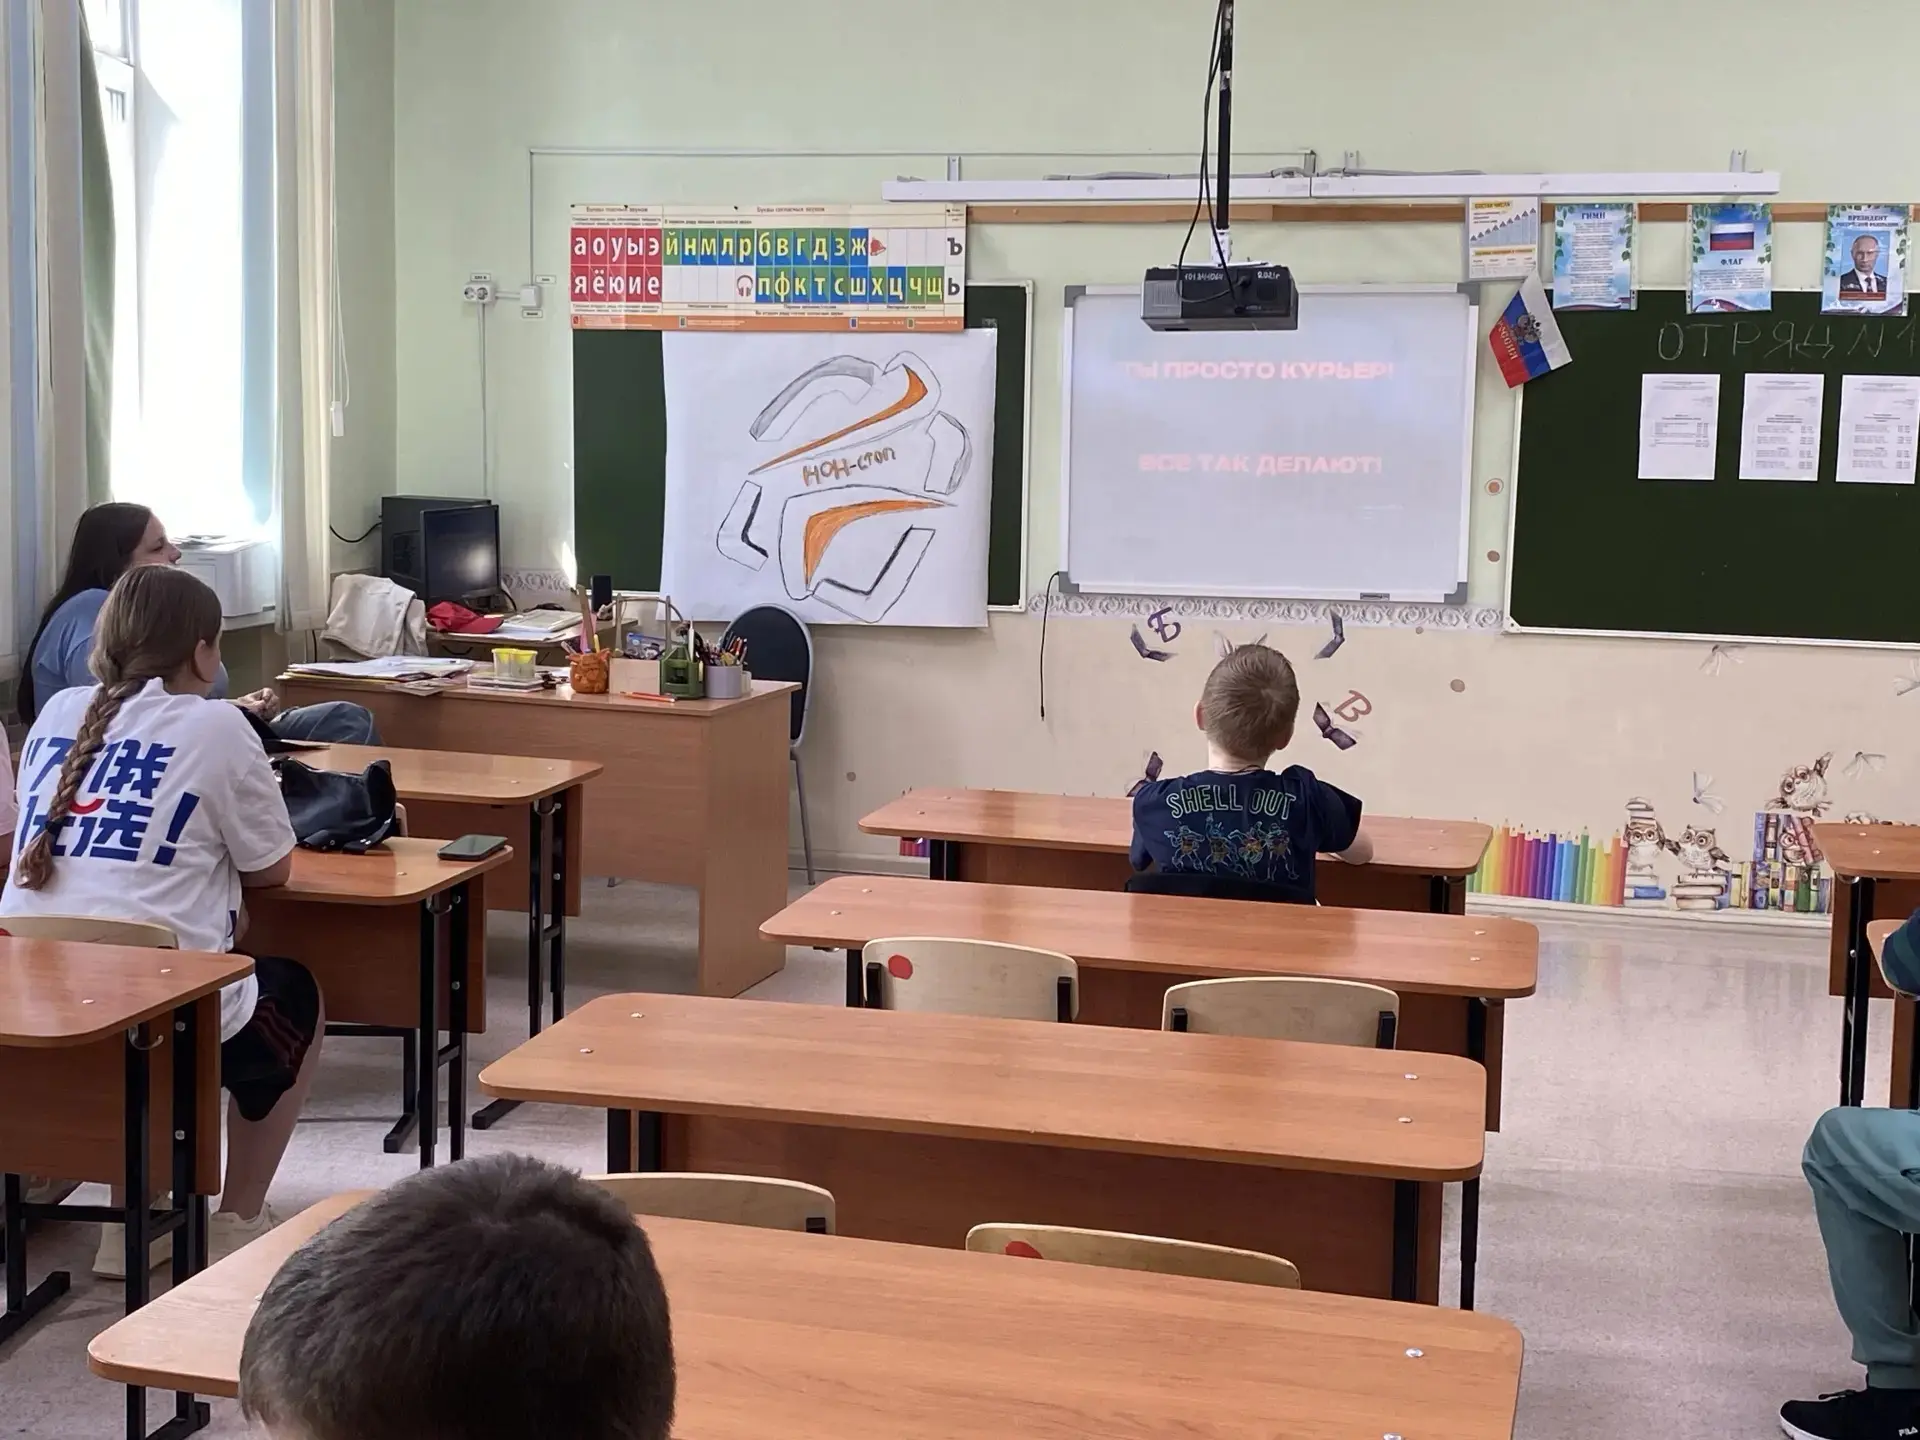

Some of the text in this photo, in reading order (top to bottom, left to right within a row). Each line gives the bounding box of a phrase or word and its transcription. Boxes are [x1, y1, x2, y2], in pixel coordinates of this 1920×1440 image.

[1720, 258, 1744, 266] ФЛАГ
[1658, 321, 1835, 361] ОТРЯД
[1119, 361, 1394, 380] ТЫ ПРОСТО КУРЬЕР!
[1138, 454, 1383, 476] ВСЕ ТАК ДЕЛАЮТ!
[1166, 783, 1297, 820] SHELL OUT
[1898, 1426, 1919, 1437] FILA
